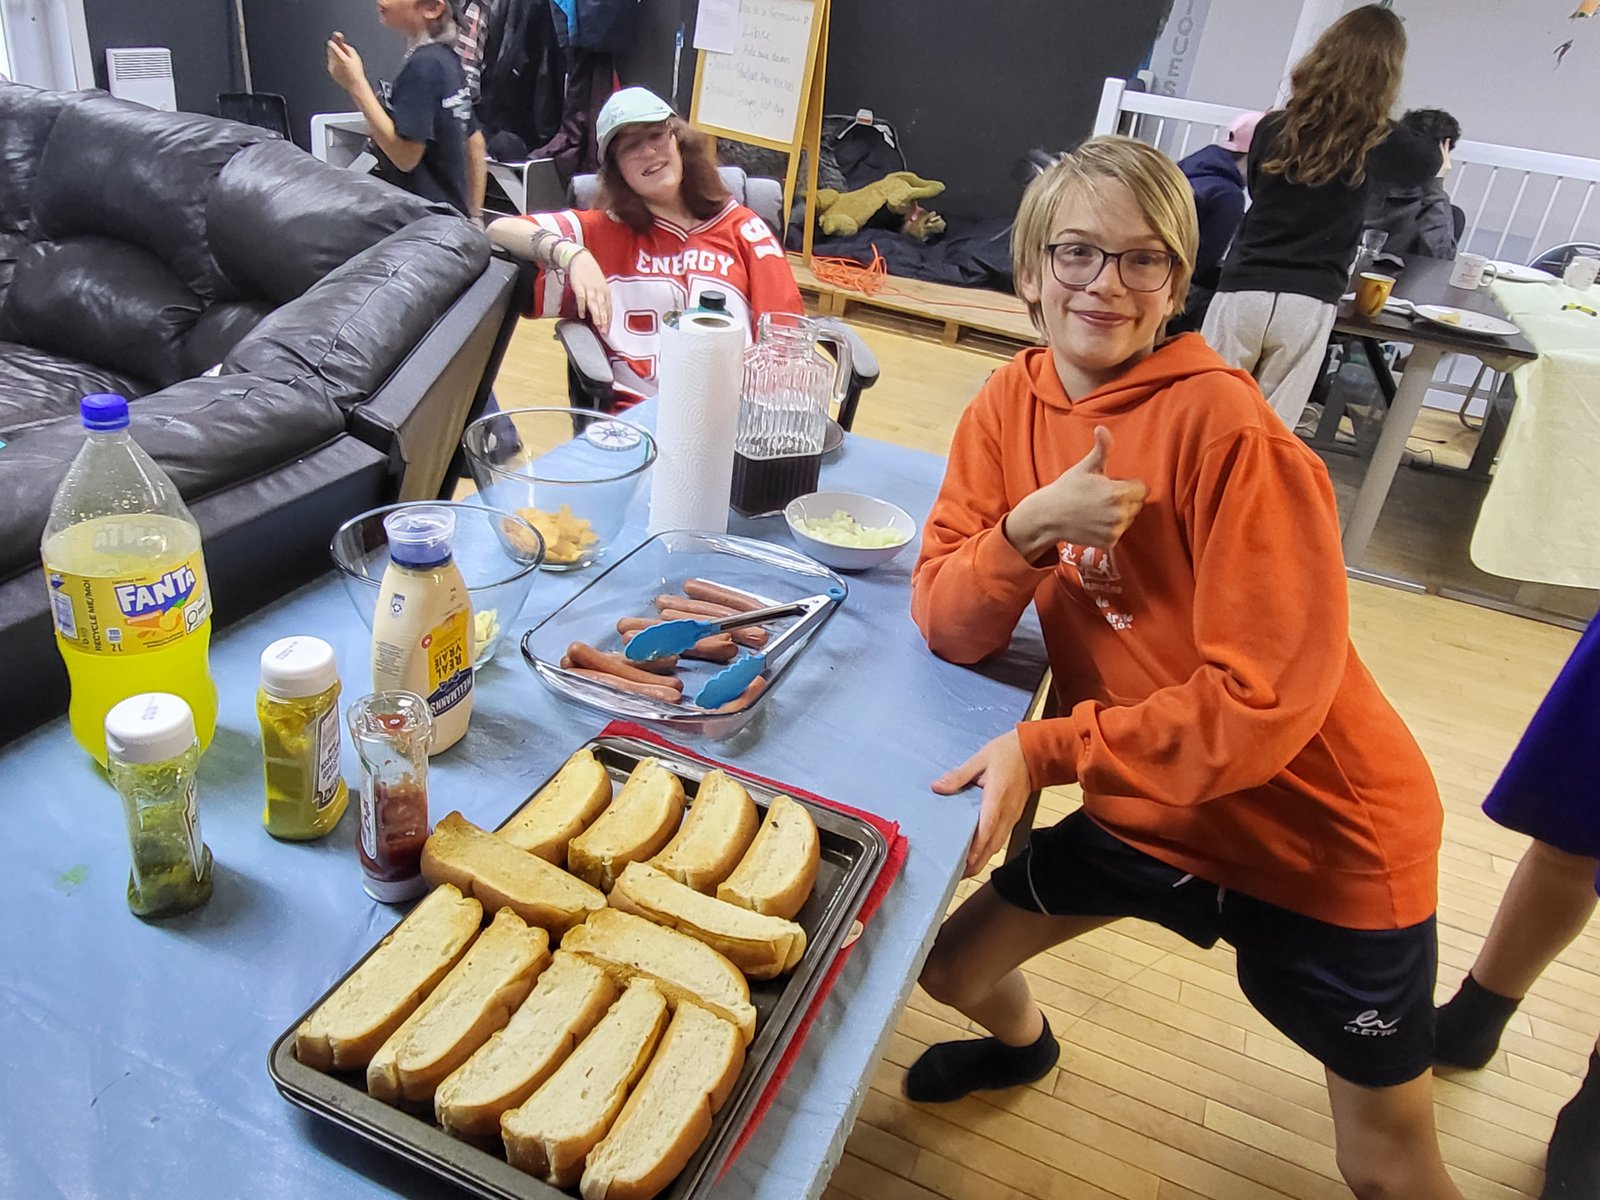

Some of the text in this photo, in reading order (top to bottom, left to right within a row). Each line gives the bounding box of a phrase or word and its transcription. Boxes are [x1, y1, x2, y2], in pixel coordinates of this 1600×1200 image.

[636, 249, 735, 277] ENERGY
[115, 566, 196, 612] FANTA
[89, 614, 103, 651] RECYCLE
[111, 643, 117, 652] 2
[434, 643, 462, 669] VRAIE
[435, 653, 463, 679] REAL
[430, 674, 472, 714] HELLMANN'S
